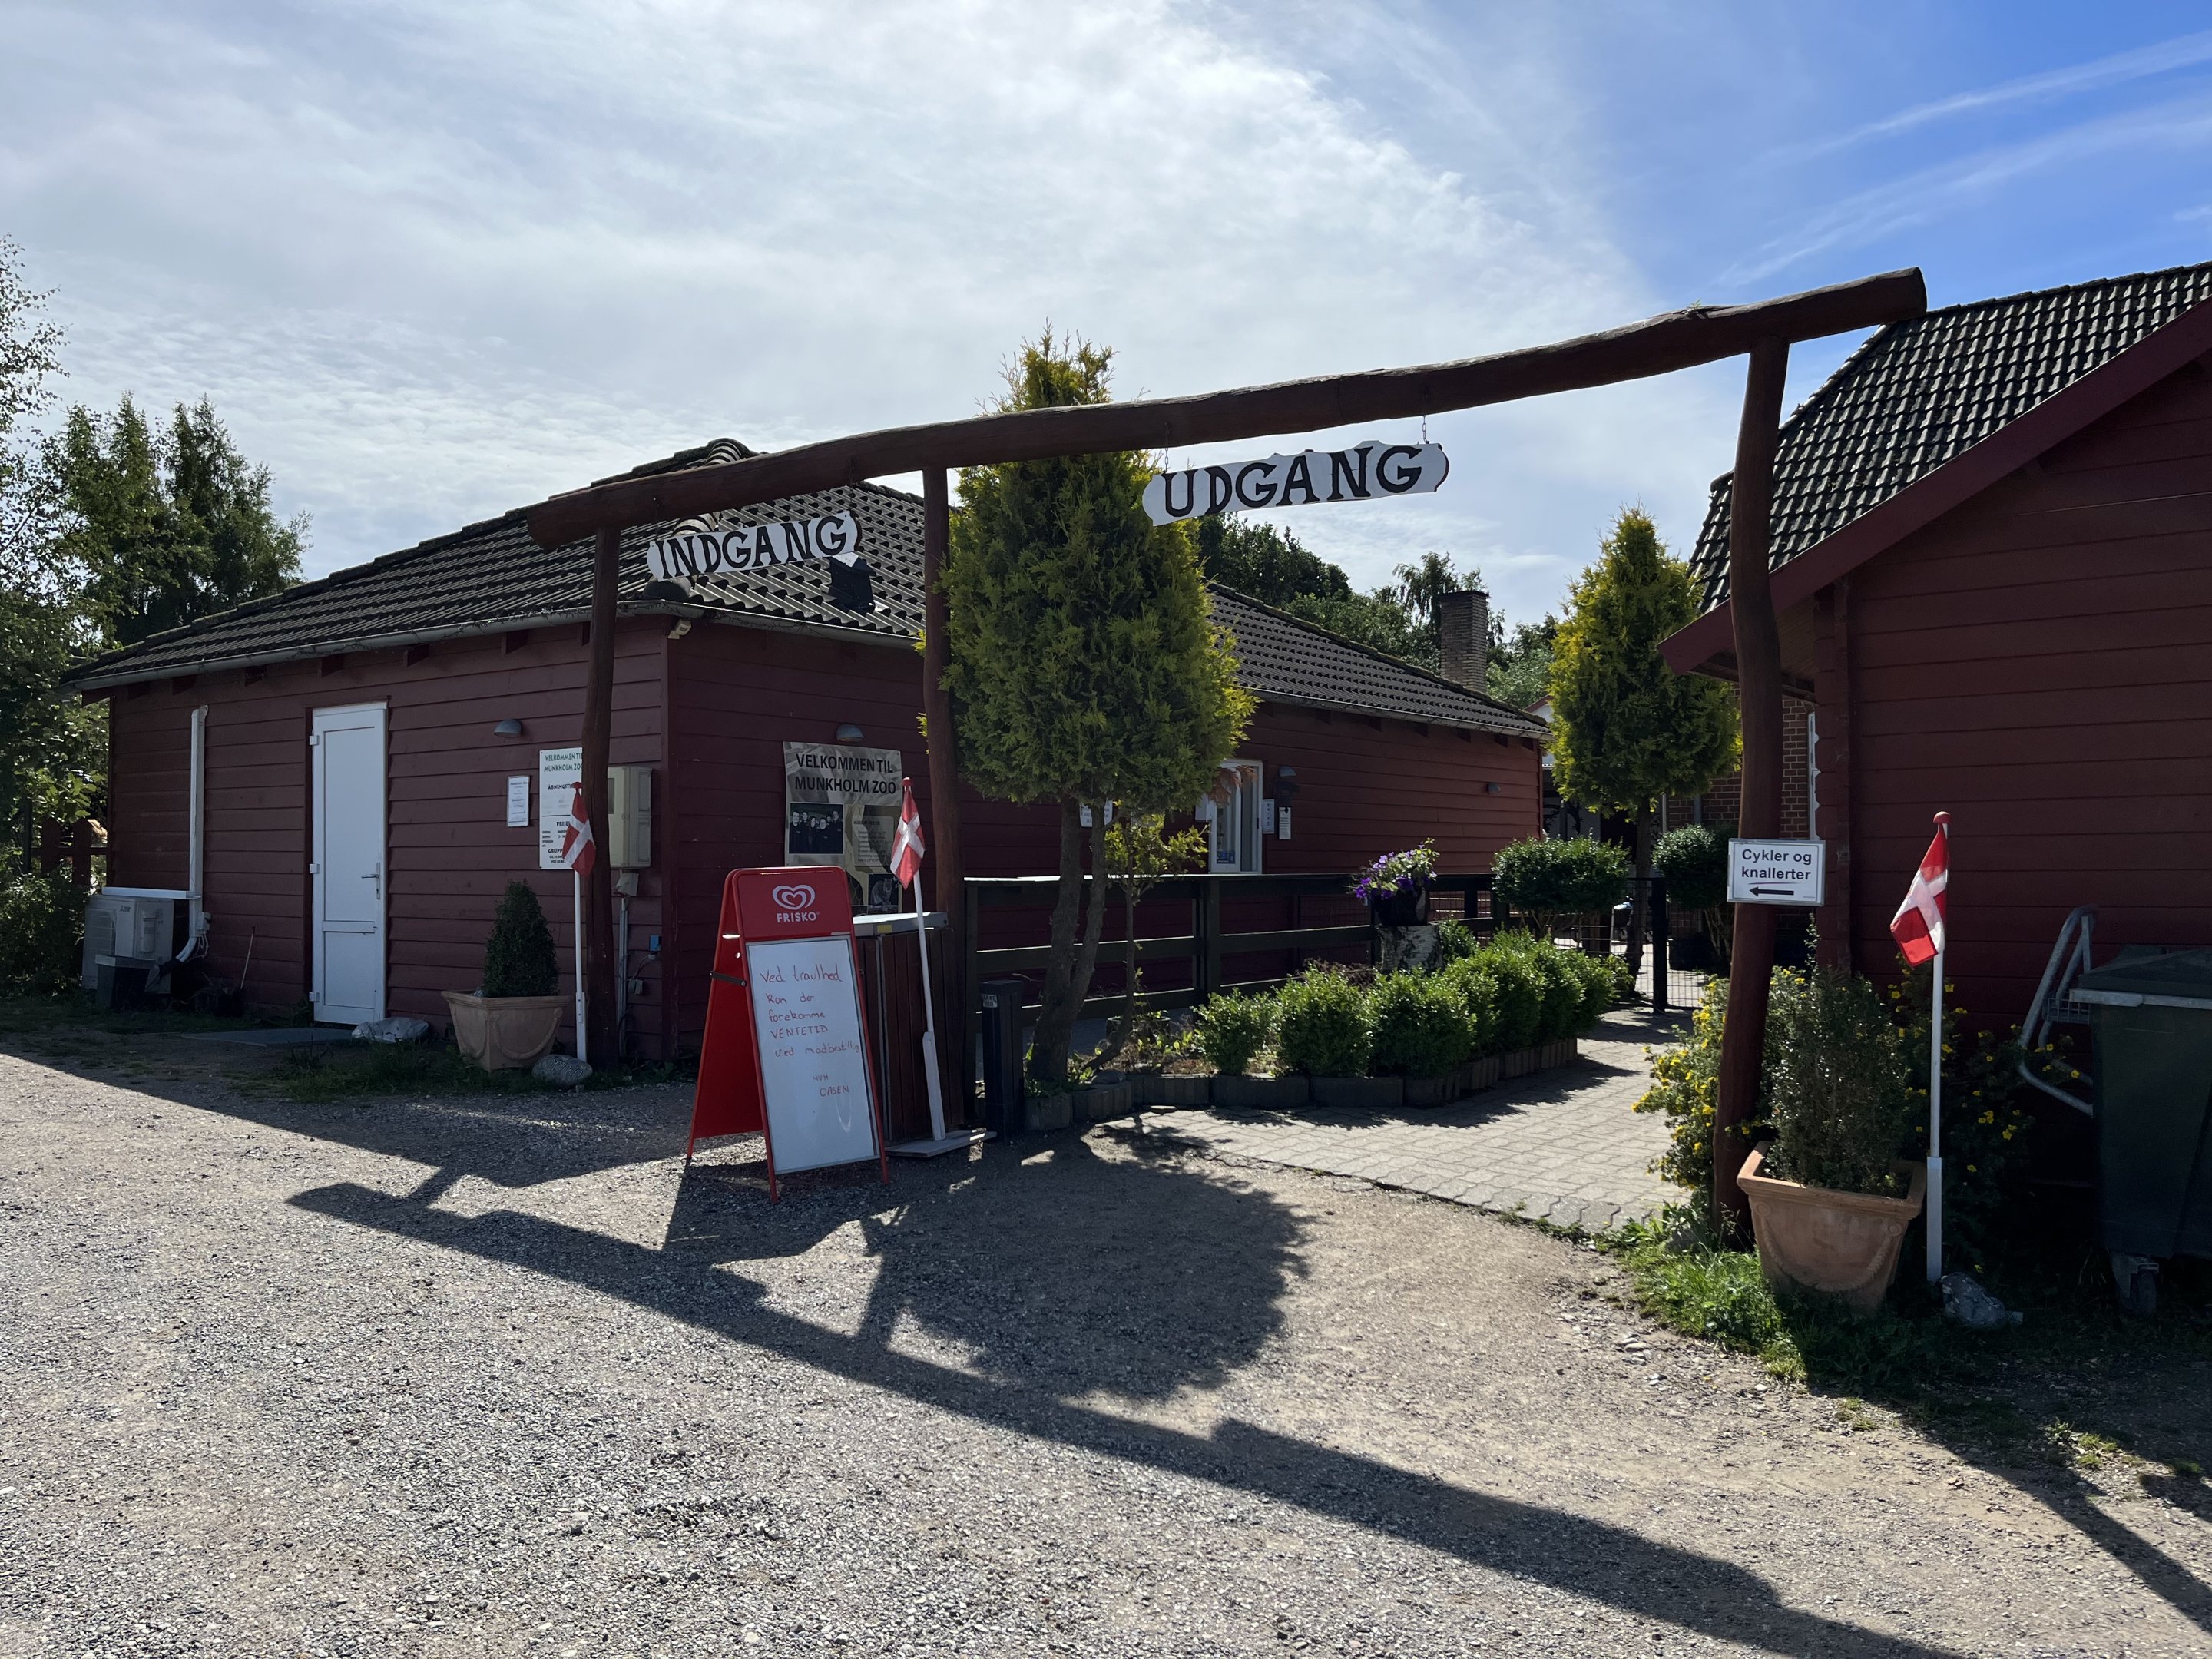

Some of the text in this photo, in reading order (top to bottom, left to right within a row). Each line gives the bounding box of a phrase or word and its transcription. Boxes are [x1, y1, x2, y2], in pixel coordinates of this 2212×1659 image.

[1162, 445, 1422, 518] UDGANG
[654, 515, 846, 578] INDGANG
[545, 753, 575, 761] VELKOMMEN
[796, 753, 894, 773] VELKOMMEN TIL
[544, 763, 573, 773] MUNKHOLM
[795, 776, 896, 794] MUNKHOLM ZOO
[1742, 849, 1812, 865] Cykler og
[1741, 866, 1811, 880] knallerter
[776, 911, 817, 922] FRISKO
[800, 991, 814, 1002] der
[769, 1008, 826, 1022] forekomme
[770, 1025, 828, 1039] VENTETID
[820, 1085, 849, 1097] OASEN
